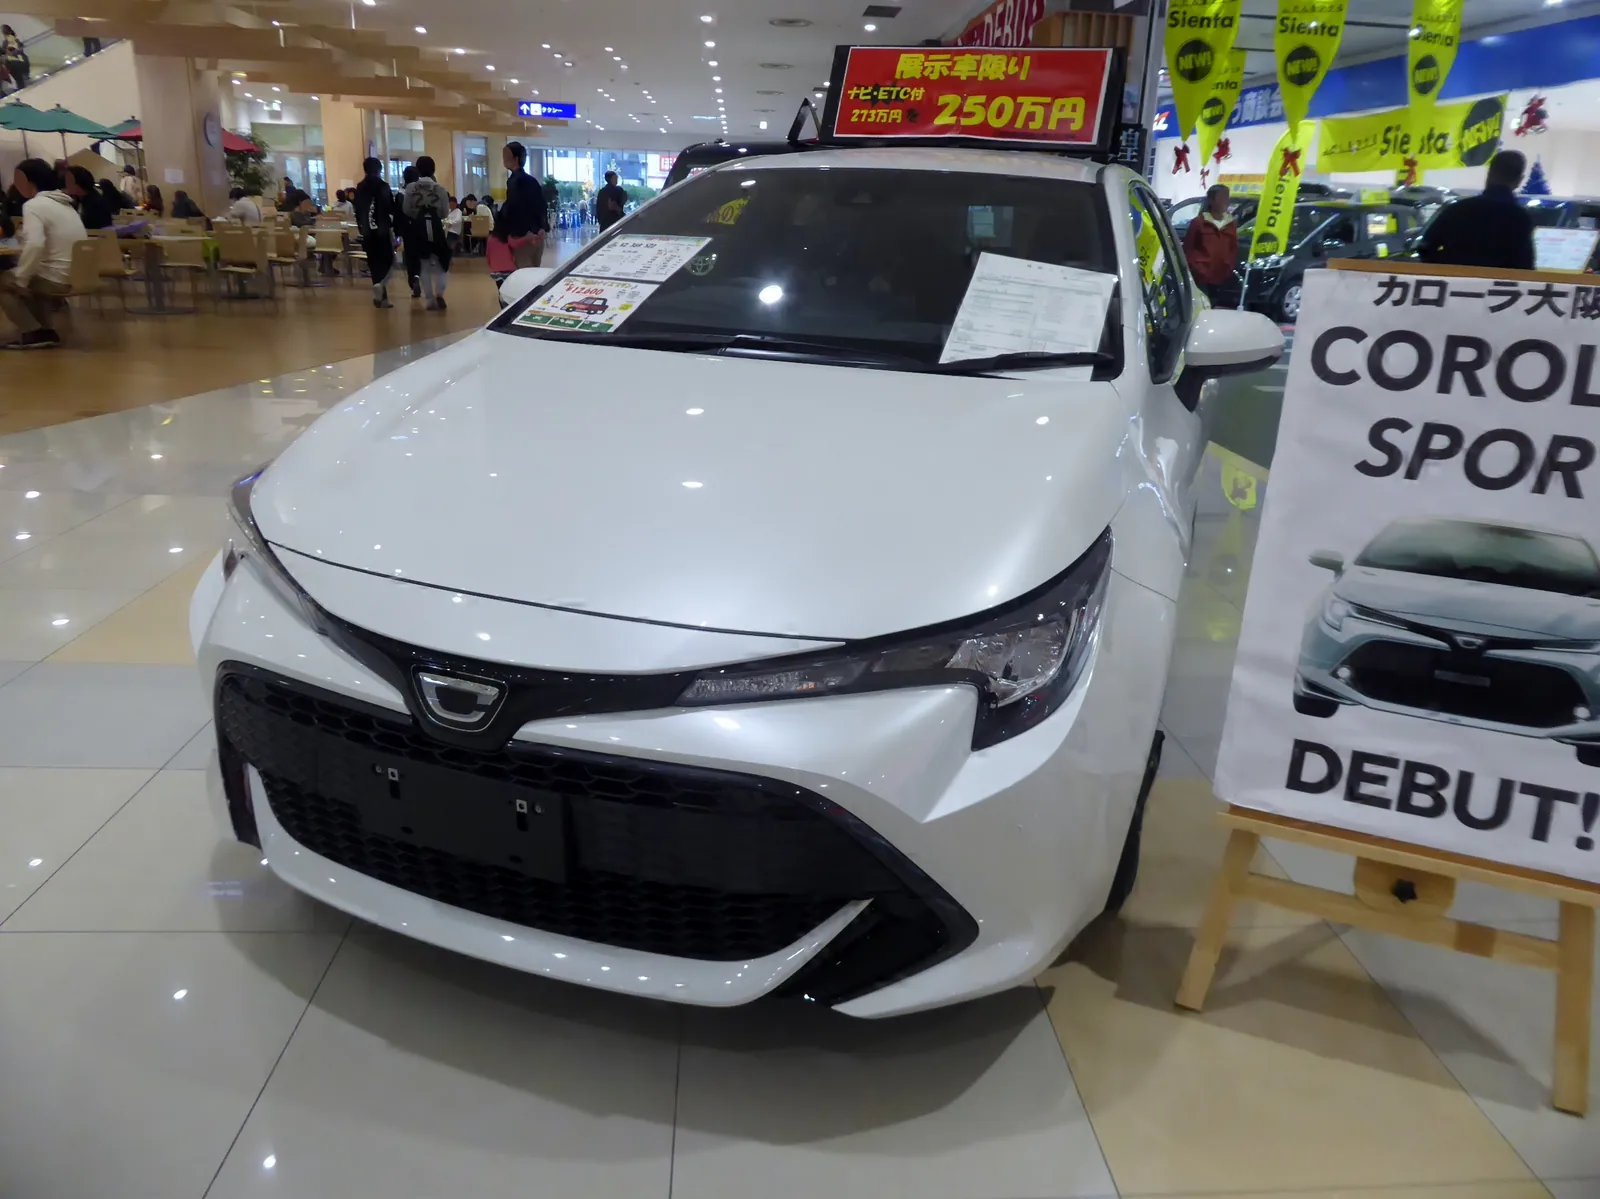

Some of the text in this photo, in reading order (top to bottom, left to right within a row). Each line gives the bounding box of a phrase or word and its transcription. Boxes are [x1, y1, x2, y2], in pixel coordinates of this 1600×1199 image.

[1168, 10, 1233, 29] Sienta
[1279, 16, 1340, 37] Sienta
[895, 53, 1031, 81] 展示車限り
[1178, 51, 1213, 71] NEW!
[850, 108, 903, 123] 273万円
[933, 94, 1086, 131] 250万円
[1310, 326, 1600, 408] COROL
[1354, 417, 1595, 499] SPOR
[1285, 738, 1600, 851] DEBUT!
